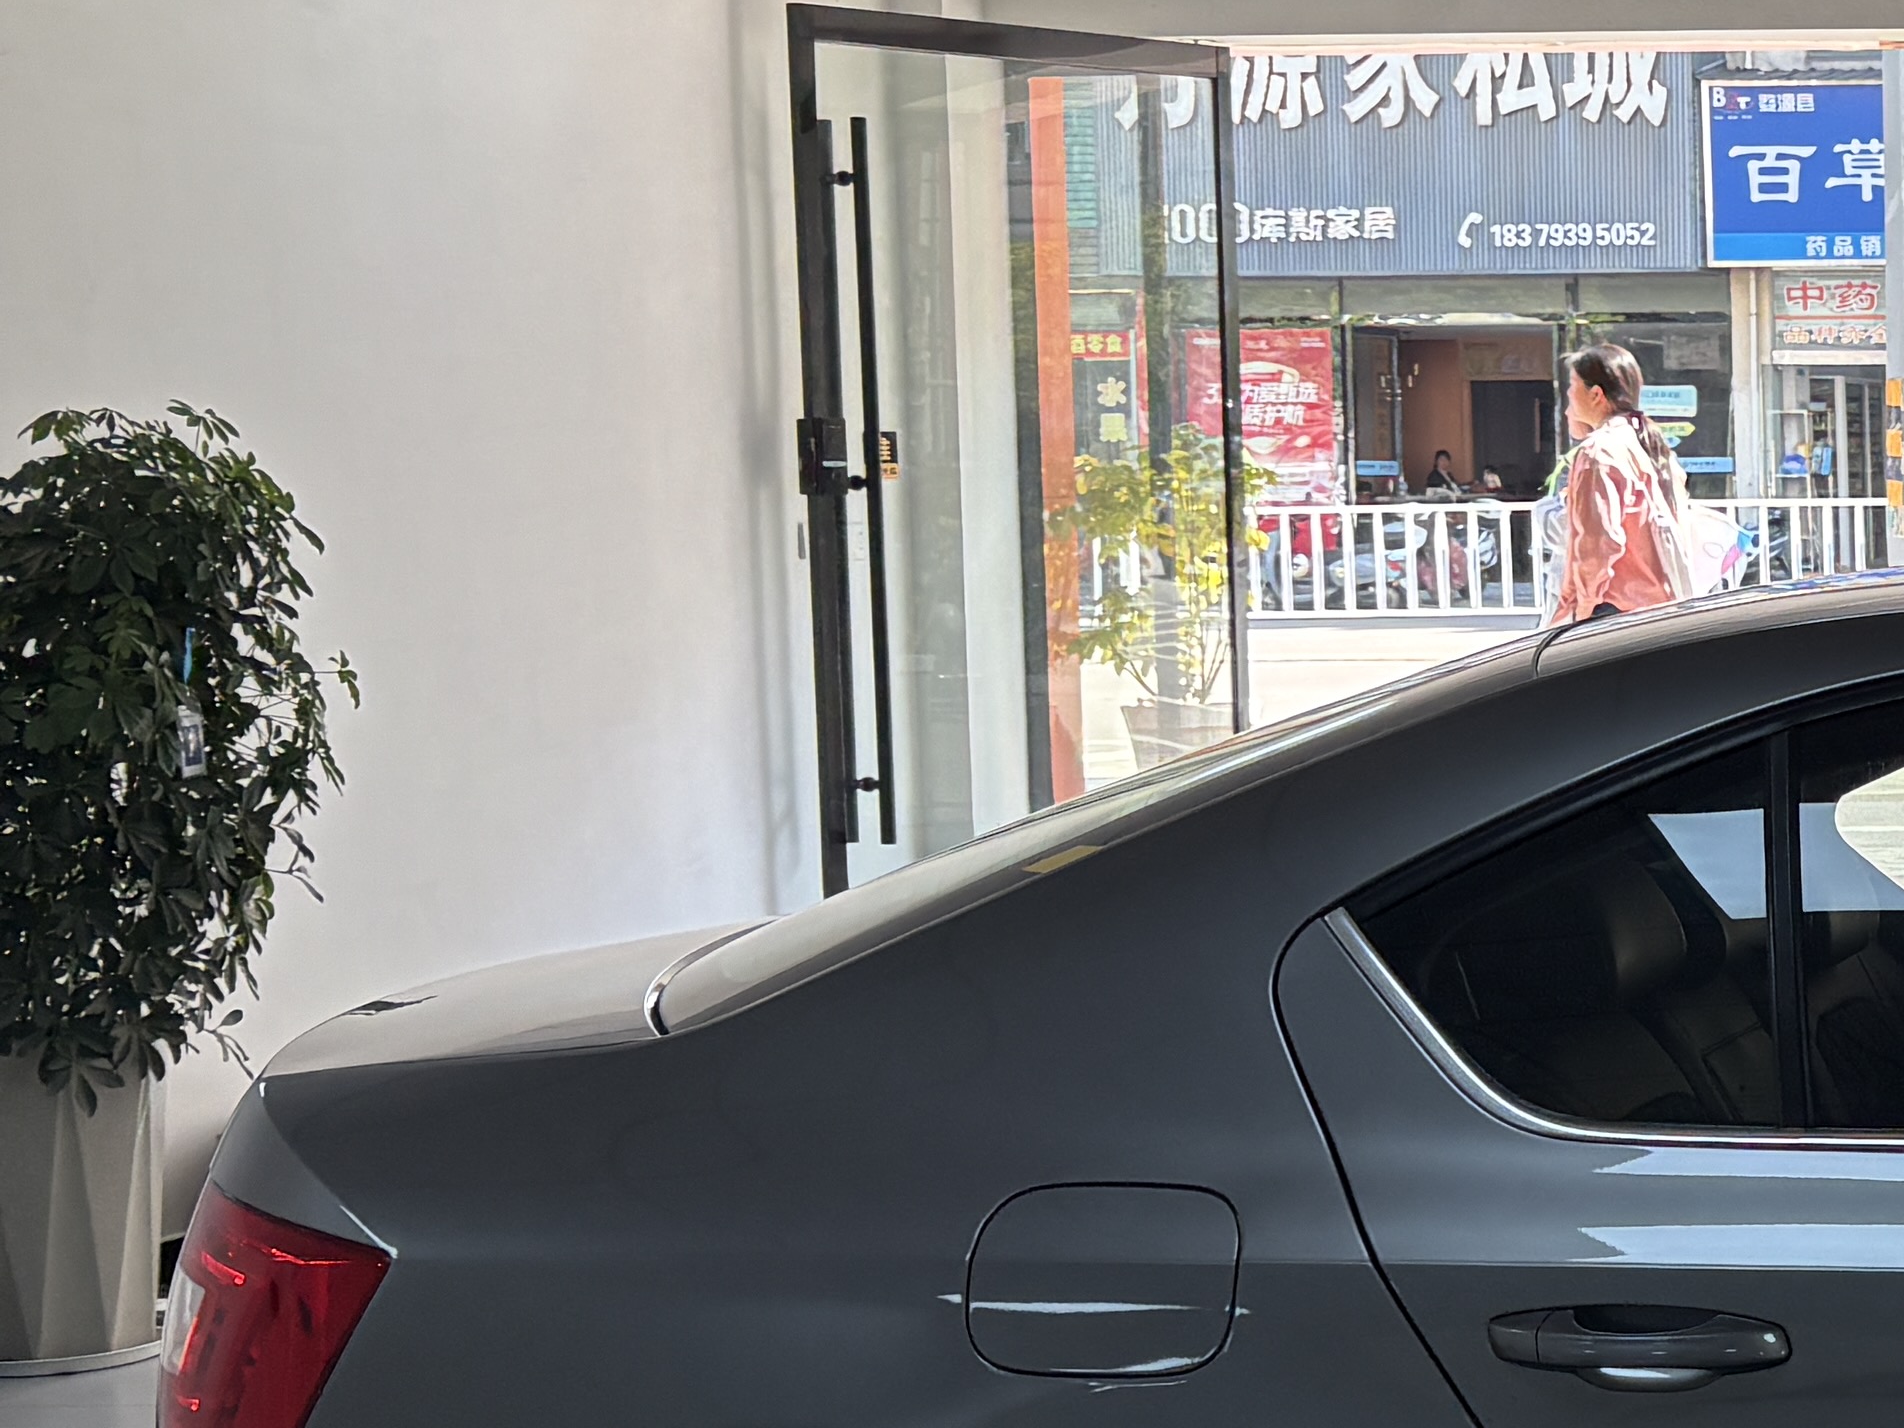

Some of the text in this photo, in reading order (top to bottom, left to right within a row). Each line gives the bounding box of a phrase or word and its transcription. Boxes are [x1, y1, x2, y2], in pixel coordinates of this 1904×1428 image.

[1728, 138, 1885, 203] 百草
[1806, 235, 1882, 257] 药品销
[1785, 279, 1881, 313] 中药
